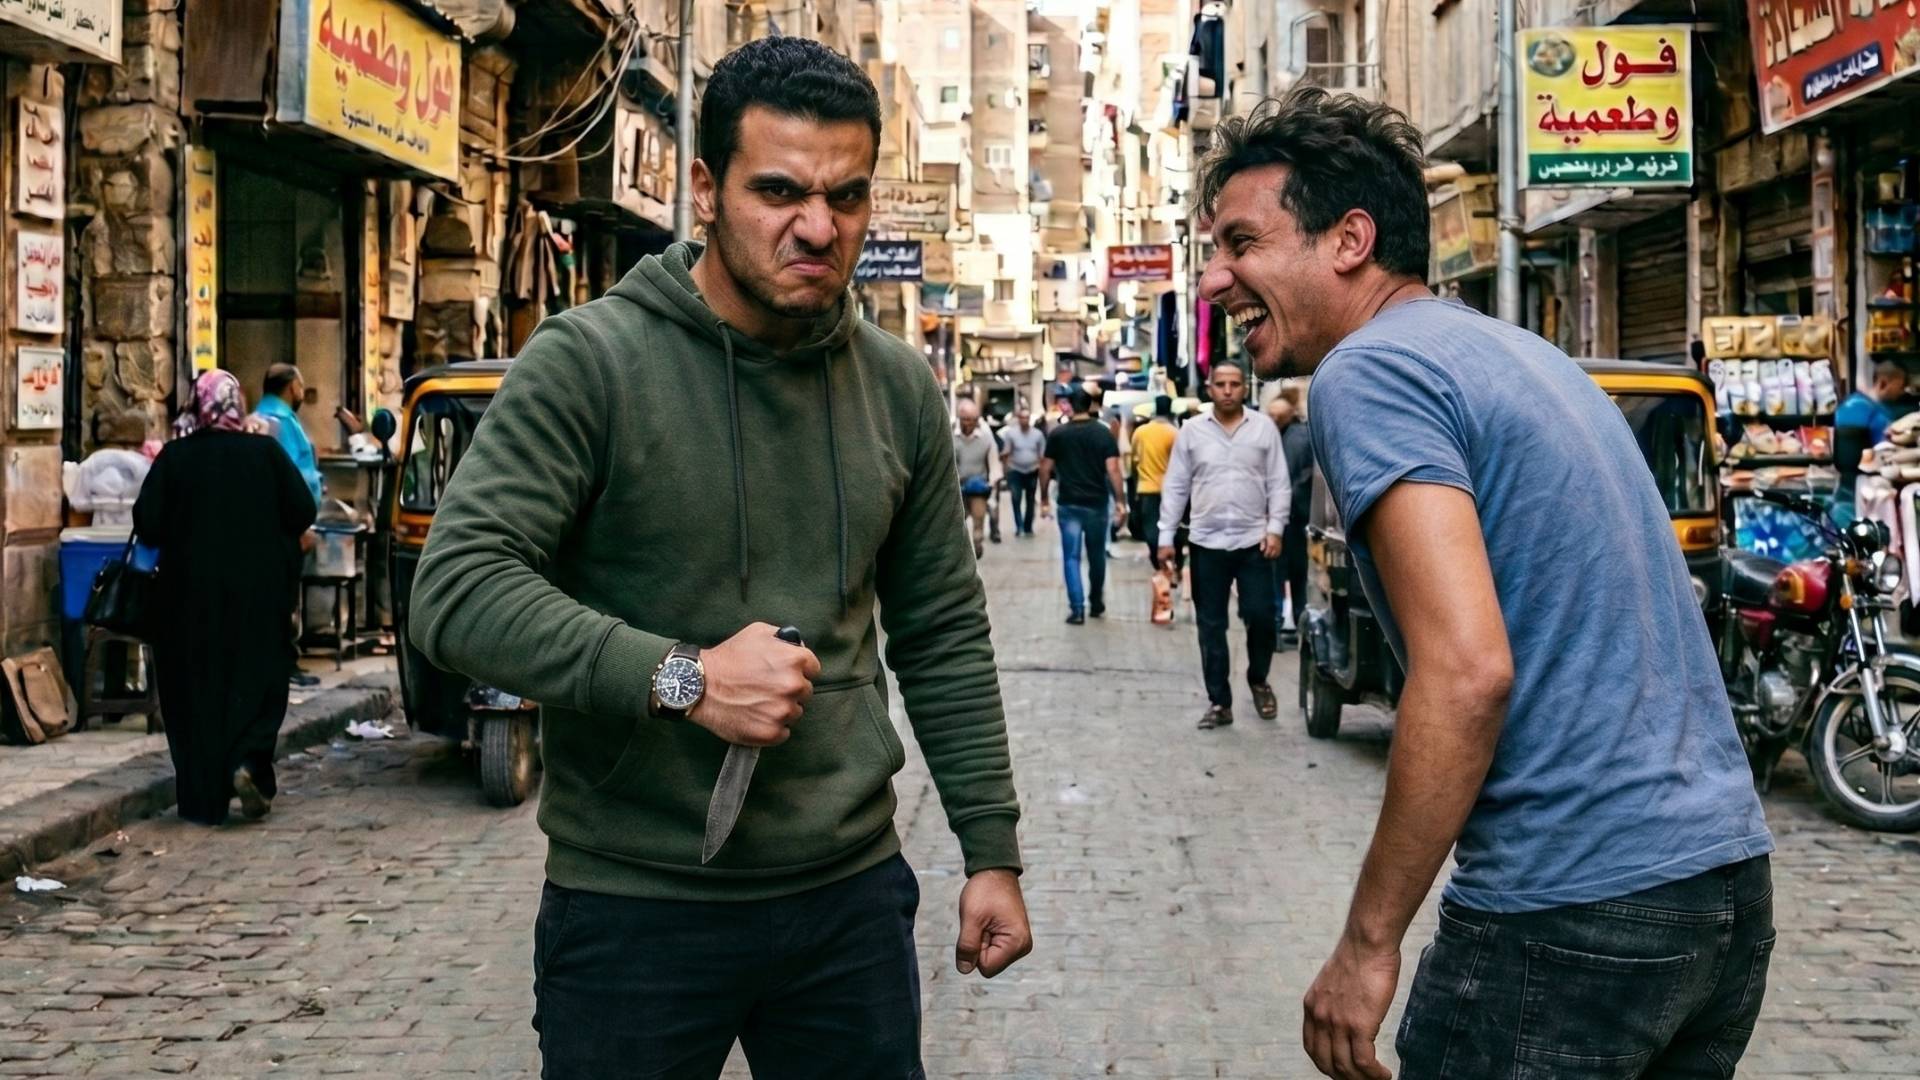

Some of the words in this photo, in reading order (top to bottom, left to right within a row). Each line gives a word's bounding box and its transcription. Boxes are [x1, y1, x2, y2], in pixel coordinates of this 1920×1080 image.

[415, 39, 454, 126] فول
[1582, 37, 1678, 86] فول
[1537, 94, 1680, 144] وطعمية
